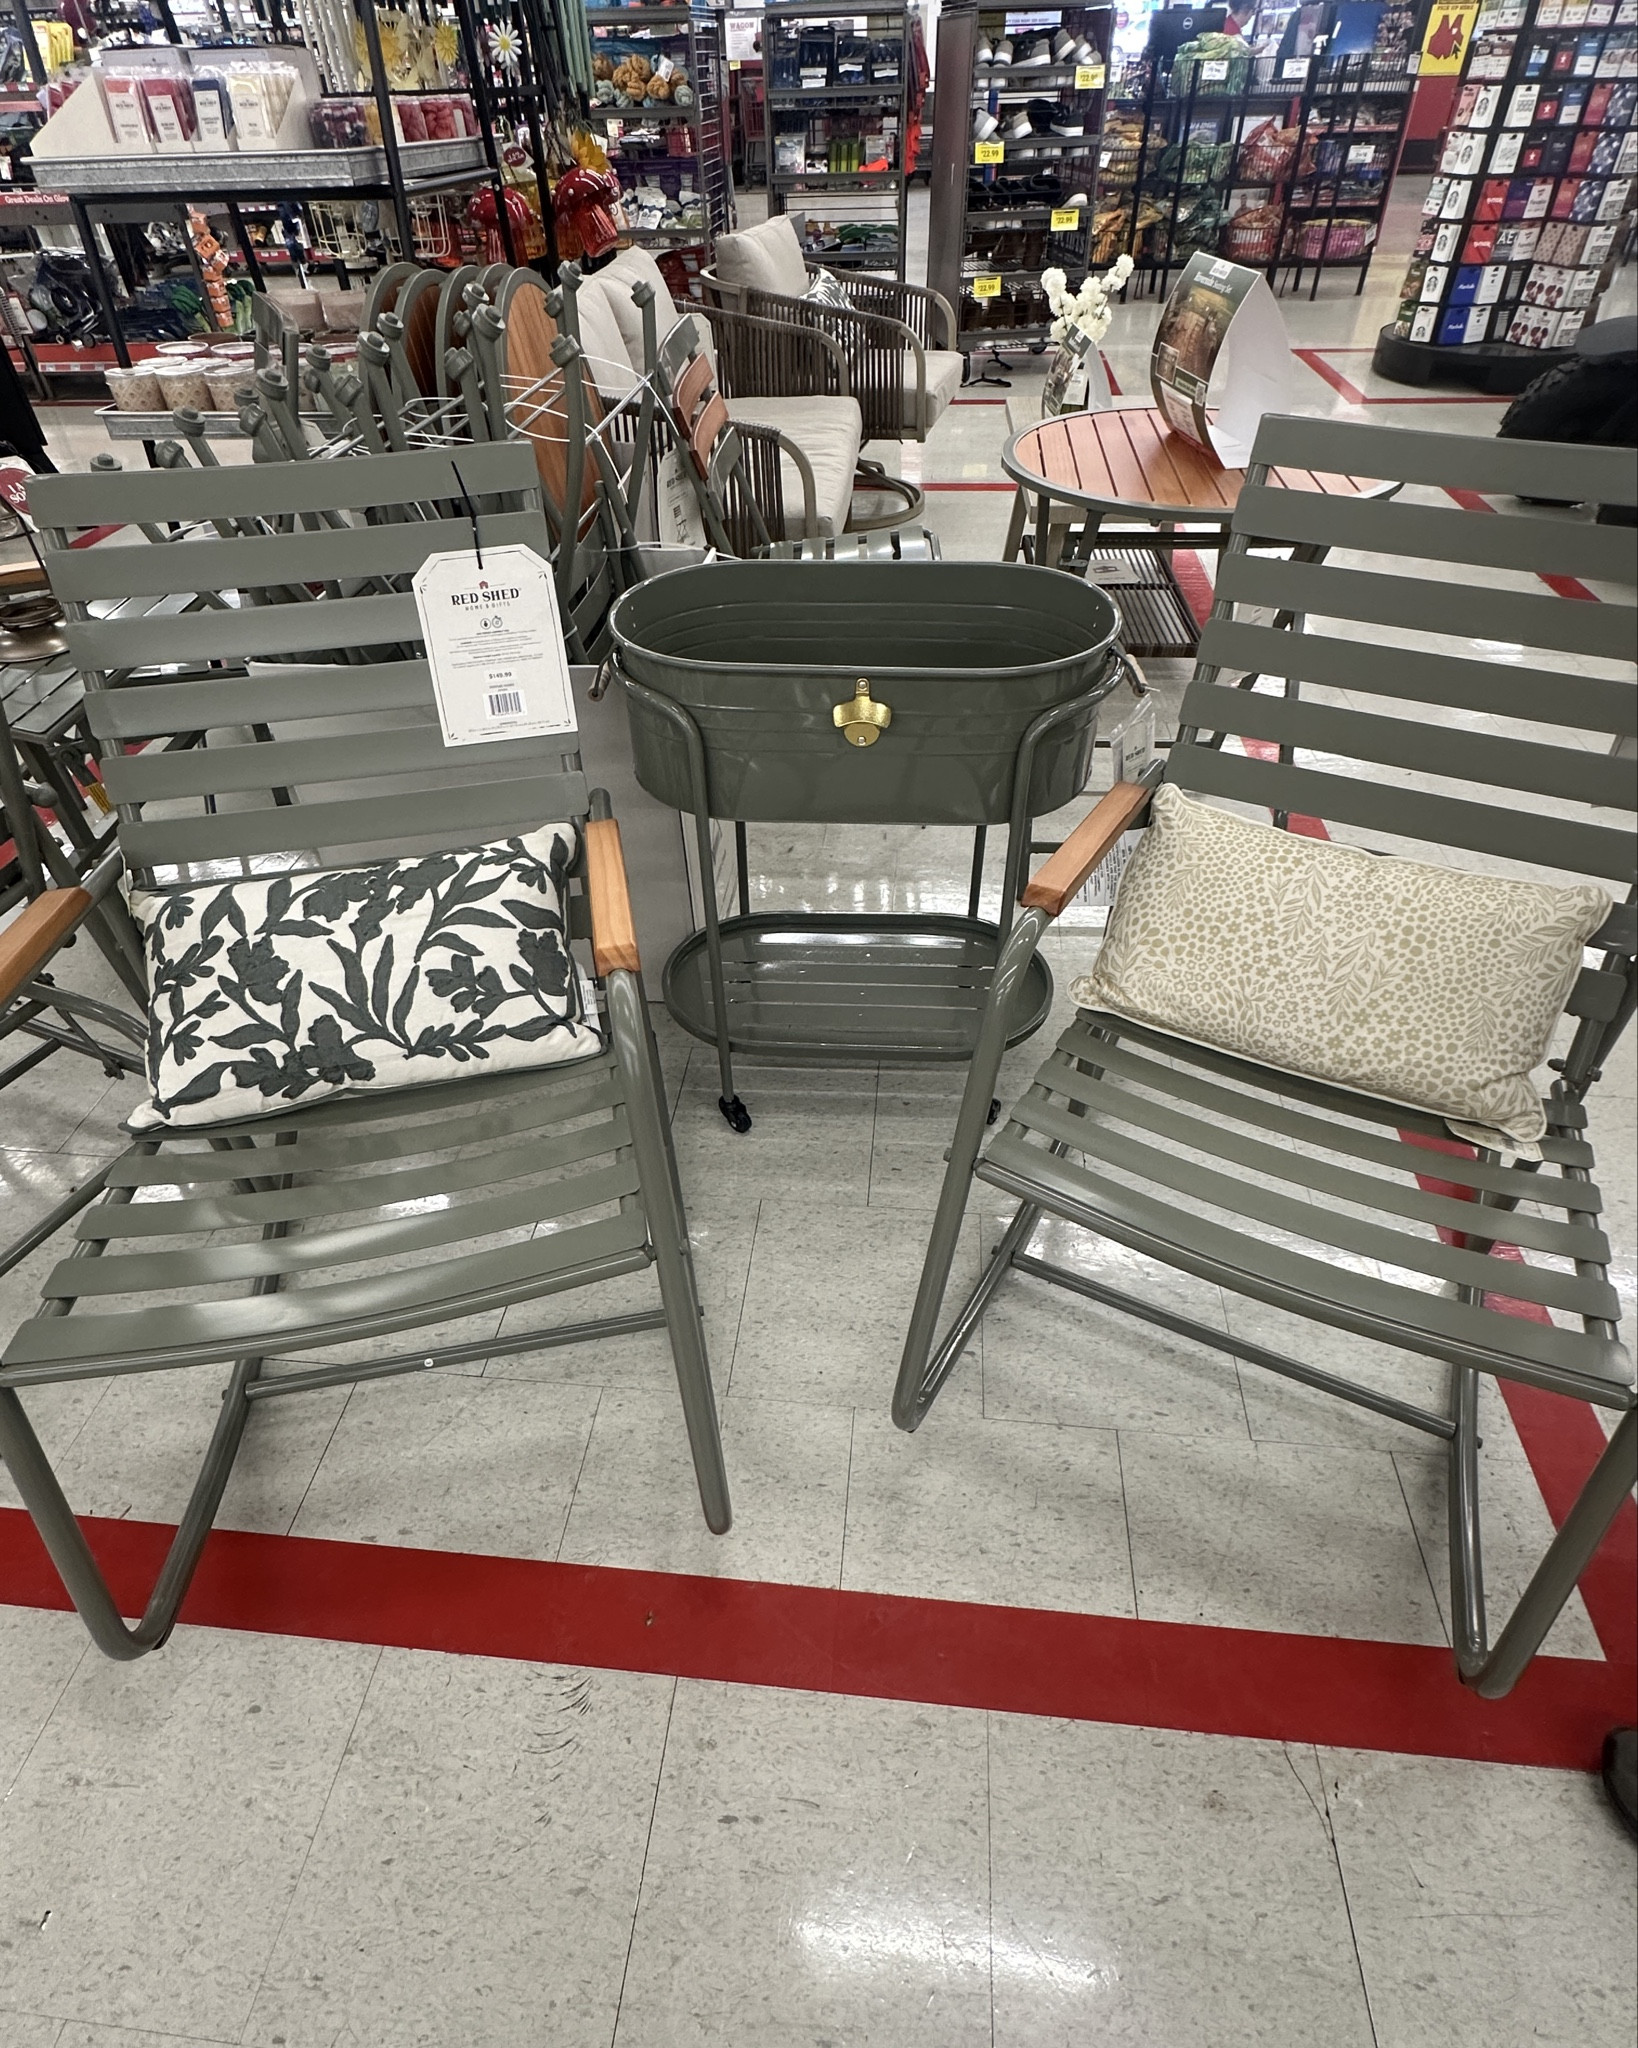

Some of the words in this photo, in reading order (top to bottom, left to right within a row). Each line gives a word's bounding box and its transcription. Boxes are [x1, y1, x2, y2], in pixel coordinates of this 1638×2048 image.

[43, 195, 54, 203] On
[451, 592, 479, 606] RED
[482, 587, 520, 602] SHED
